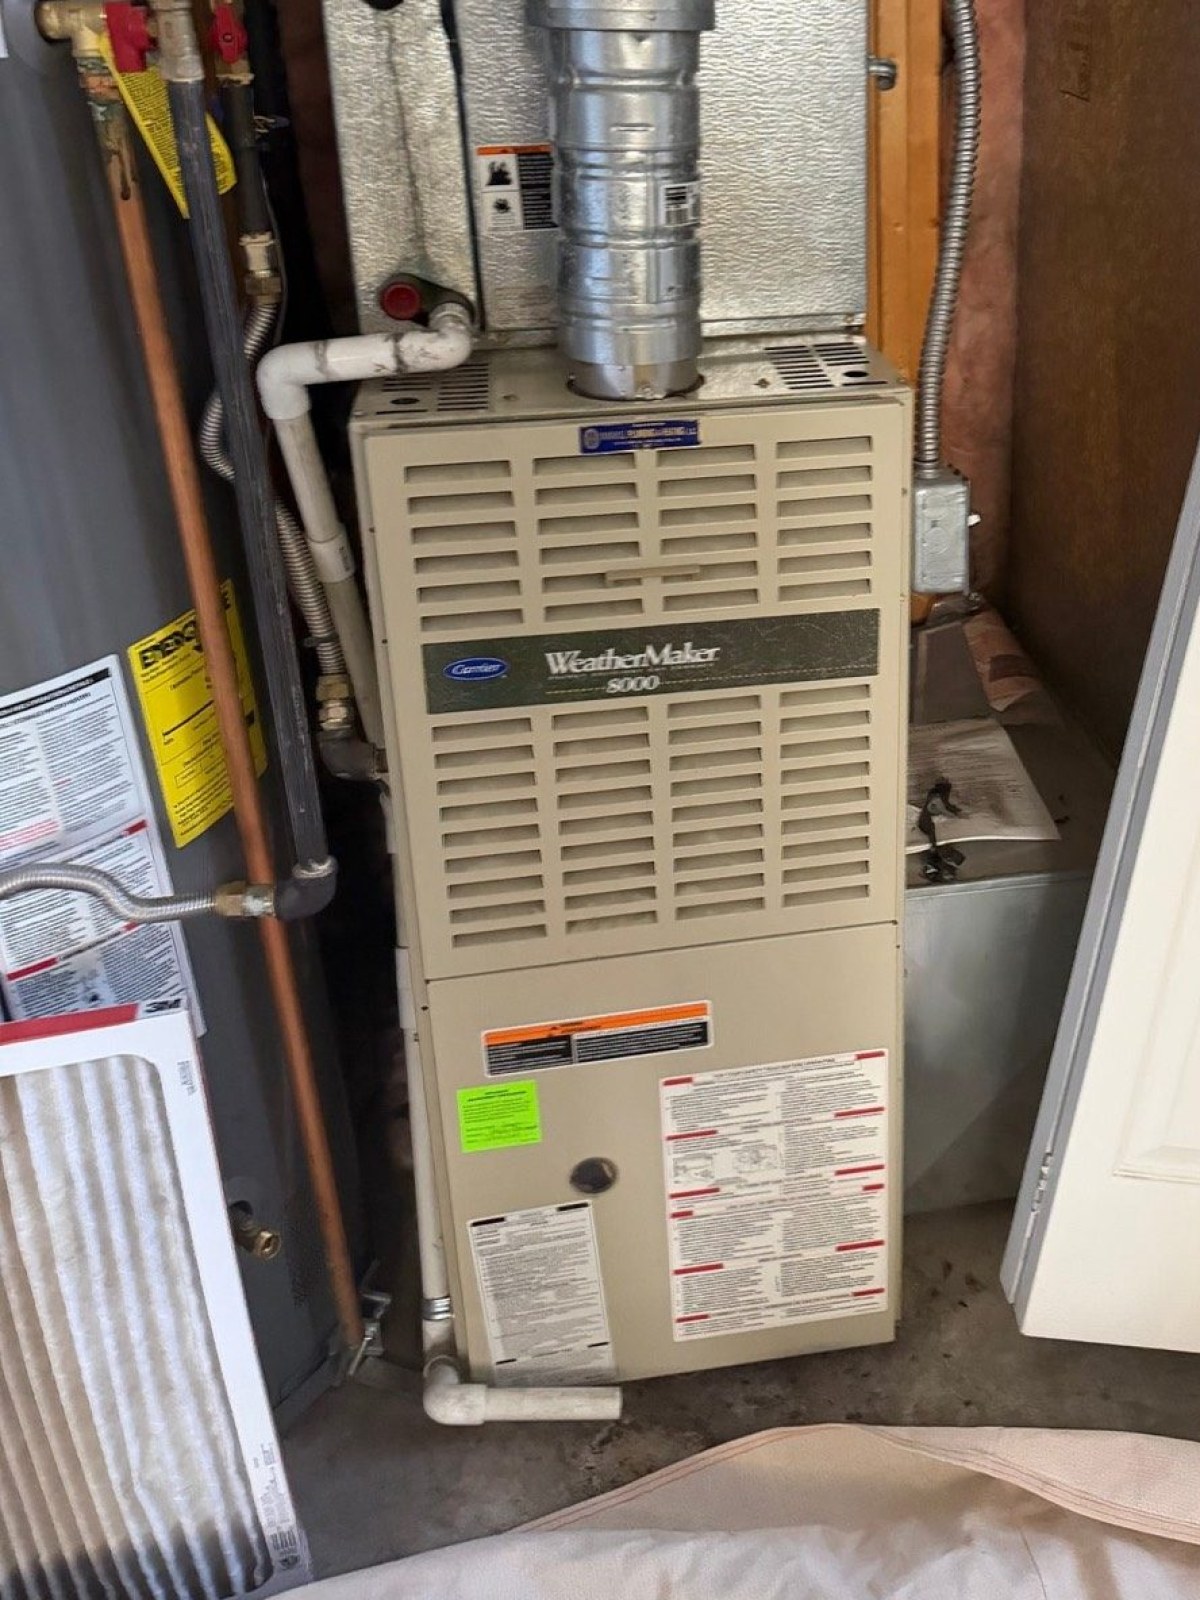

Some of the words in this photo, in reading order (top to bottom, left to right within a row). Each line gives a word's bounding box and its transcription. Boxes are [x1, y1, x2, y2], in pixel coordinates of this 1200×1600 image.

[545, 642, 720, 674] WeatherMaker
[606, 675, 660, 693] 8000
[145, 998, 181, 1013] 3M
